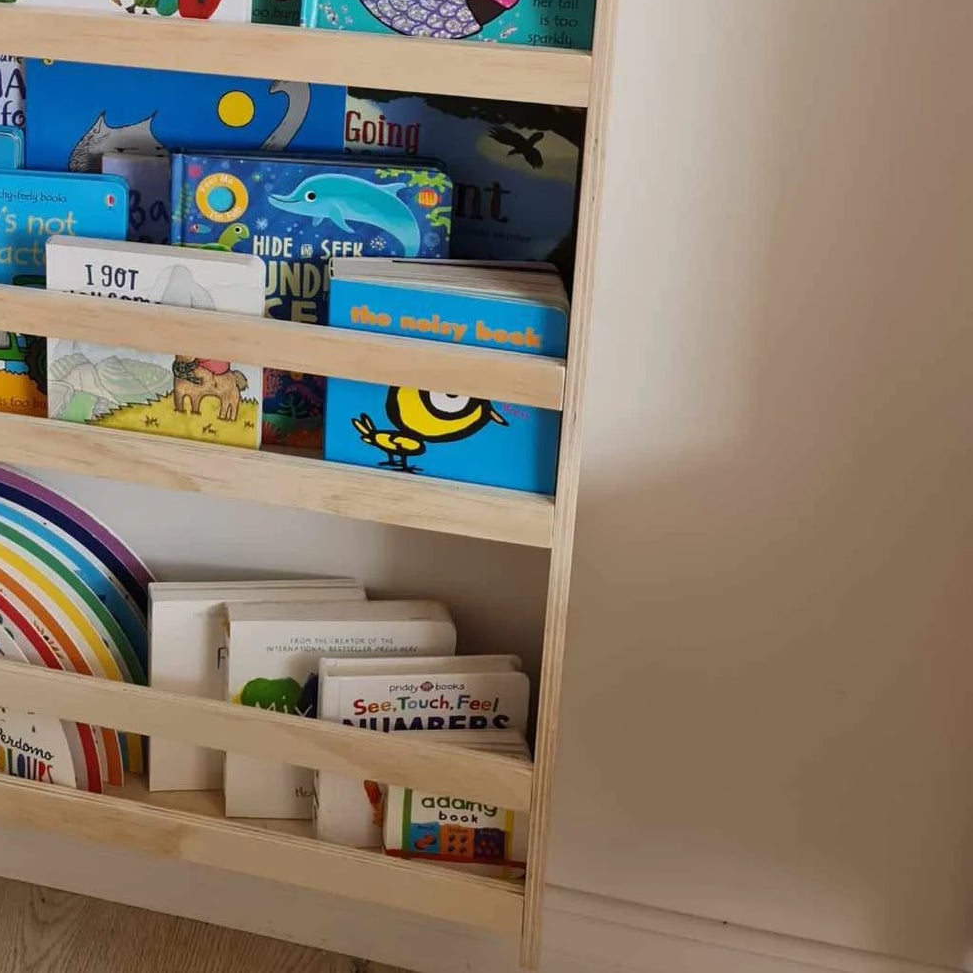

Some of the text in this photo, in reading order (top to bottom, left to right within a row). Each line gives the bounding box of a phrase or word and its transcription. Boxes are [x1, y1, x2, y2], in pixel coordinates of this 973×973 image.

[540, 15, 578, 29] is too
[344, 110, 421, 156] Going
[39, 191, 68, 204] books
[27, 210, 78, 237] not
[253, 235, 294, 258] HIDE
[84, 263, 95, 287] I
[350, 304, 543, 349] the noisy book
[0, 395, 8, 407] is
[10, 397, 30, 409] too
[314, 637, 328, 645] THE
[367, 637, 378, 645] OF
[380, 637, 394, 645] THE
[388, 682, 466, 694] priddy books
[352, 694, 500, 716] See, Touch, Feel
[438, 810, 479, 824] book
